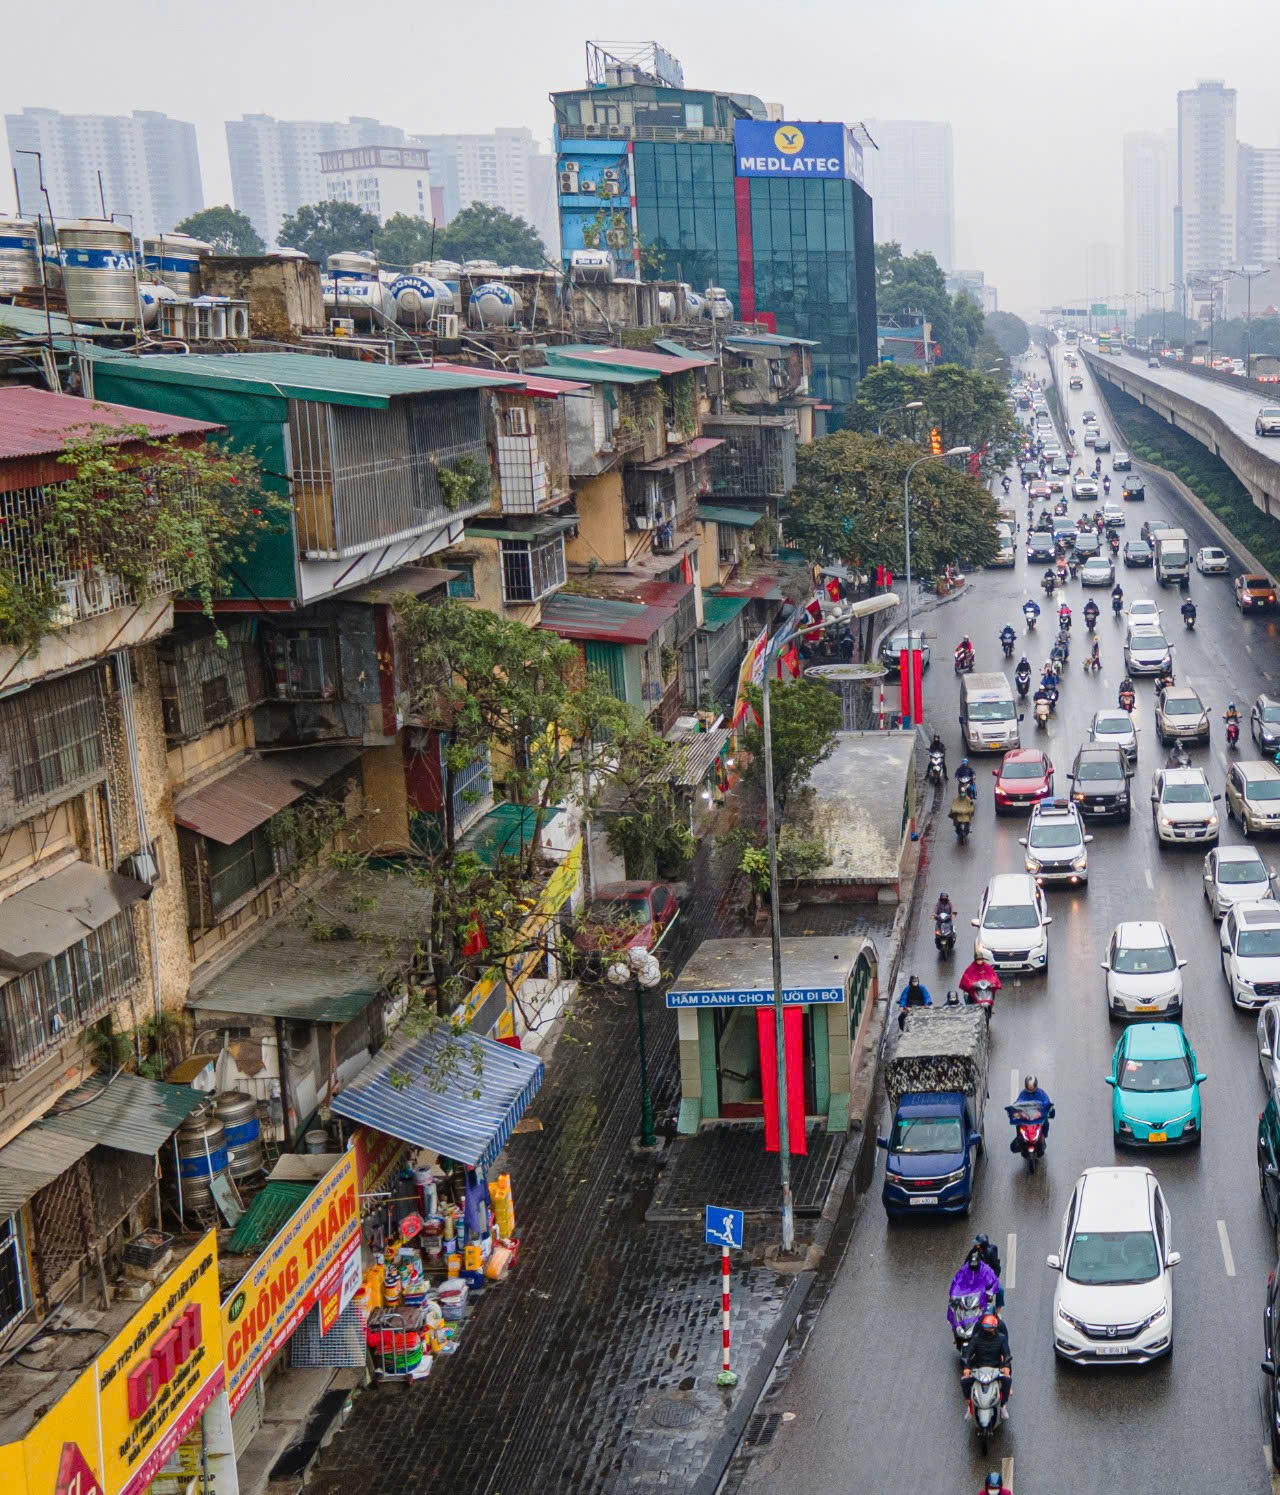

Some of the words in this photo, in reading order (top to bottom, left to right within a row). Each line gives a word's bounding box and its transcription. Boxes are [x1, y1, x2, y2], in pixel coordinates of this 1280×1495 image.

[740, 157, 840, 172] MEDLATEC
[672, 992, 699, 1005] HẦM
[701, 992, 735, 1004] DÀNH
[738, 993, 764, 1003] CHO
[767, 990, 804, 1003] NƯỜI
[806, 991, 819, 1001] ĐI
[821, 988, 839, 1003] BỘ
[227, 1255, 299, 1372] CHỐNG
[303, 1183, 356, 1270] THẤM
[127, 1303, 202, 1420] DTH
